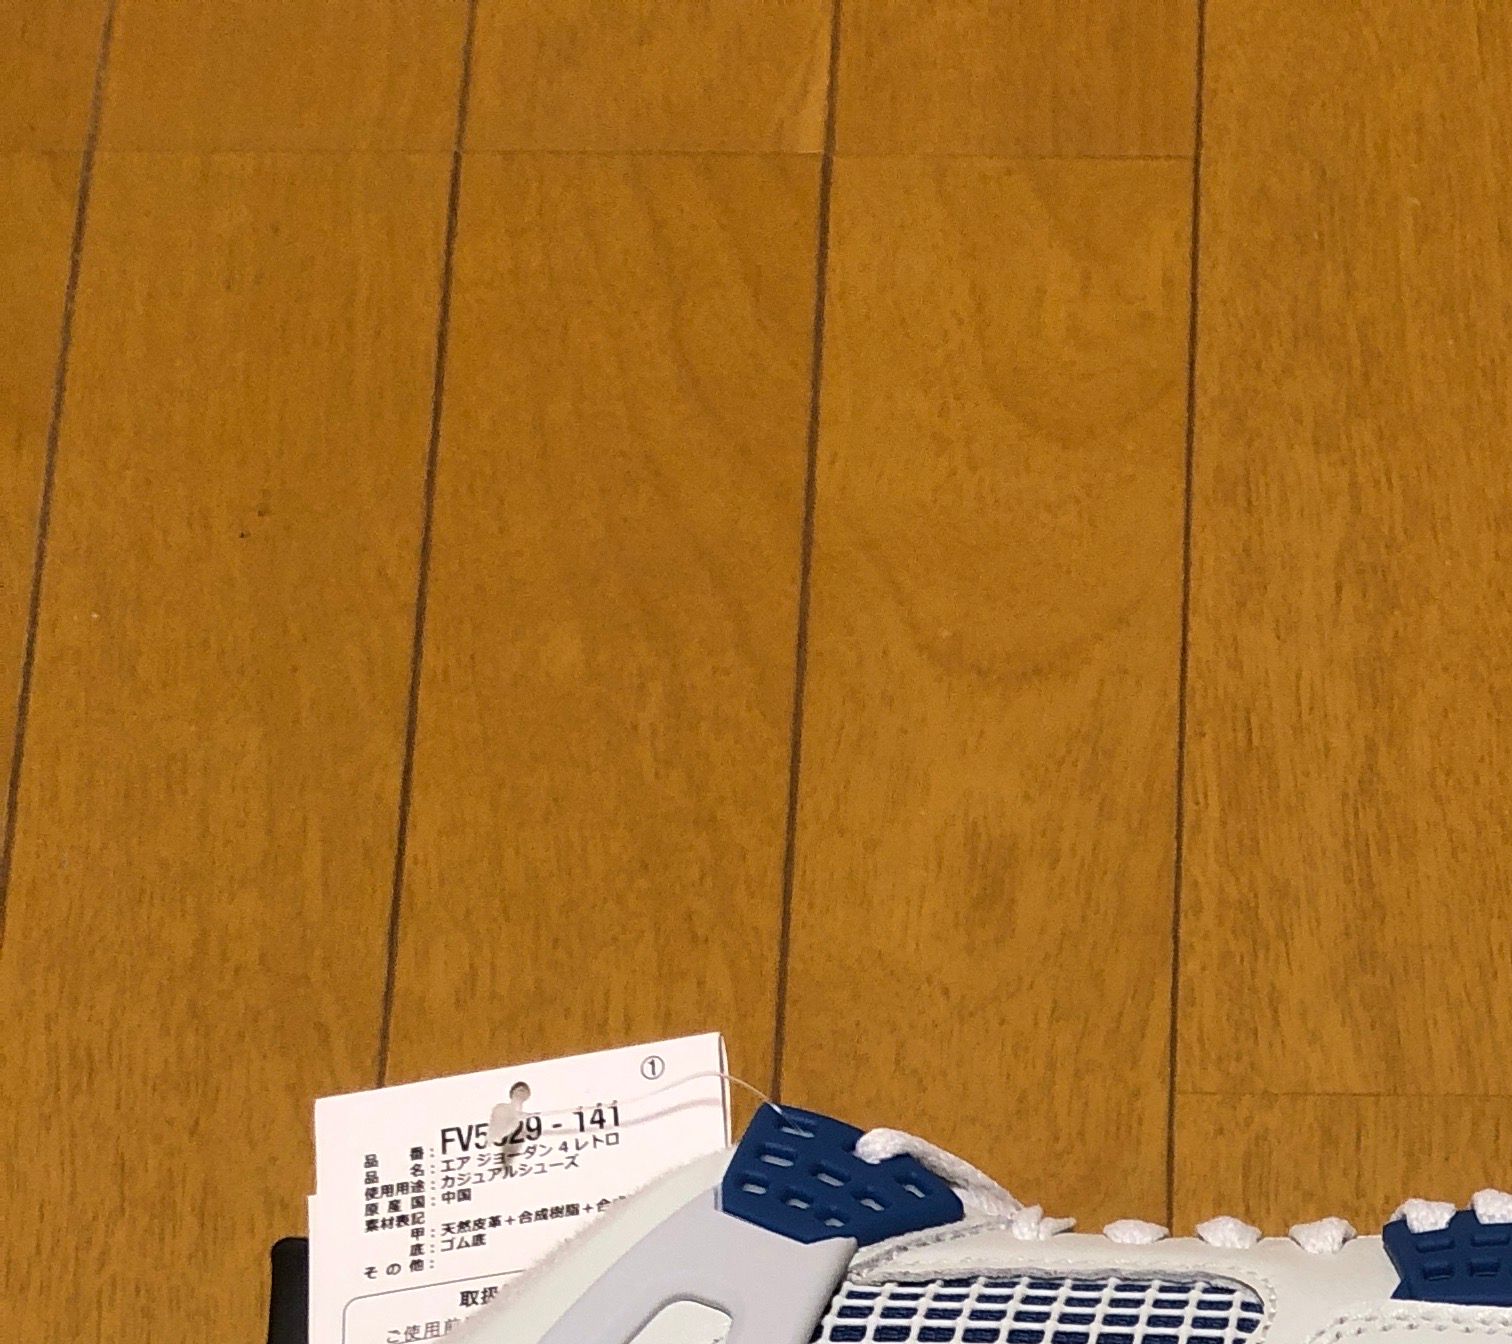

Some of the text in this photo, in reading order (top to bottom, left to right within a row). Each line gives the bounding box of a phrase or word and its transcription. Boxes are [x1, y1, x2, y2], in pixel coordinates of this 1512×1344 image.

[441, 1115, 543, 1155] FV529
[441, 1188, 472, 1204] 中国
[440, 1233, 487, 1252] ゴム底
